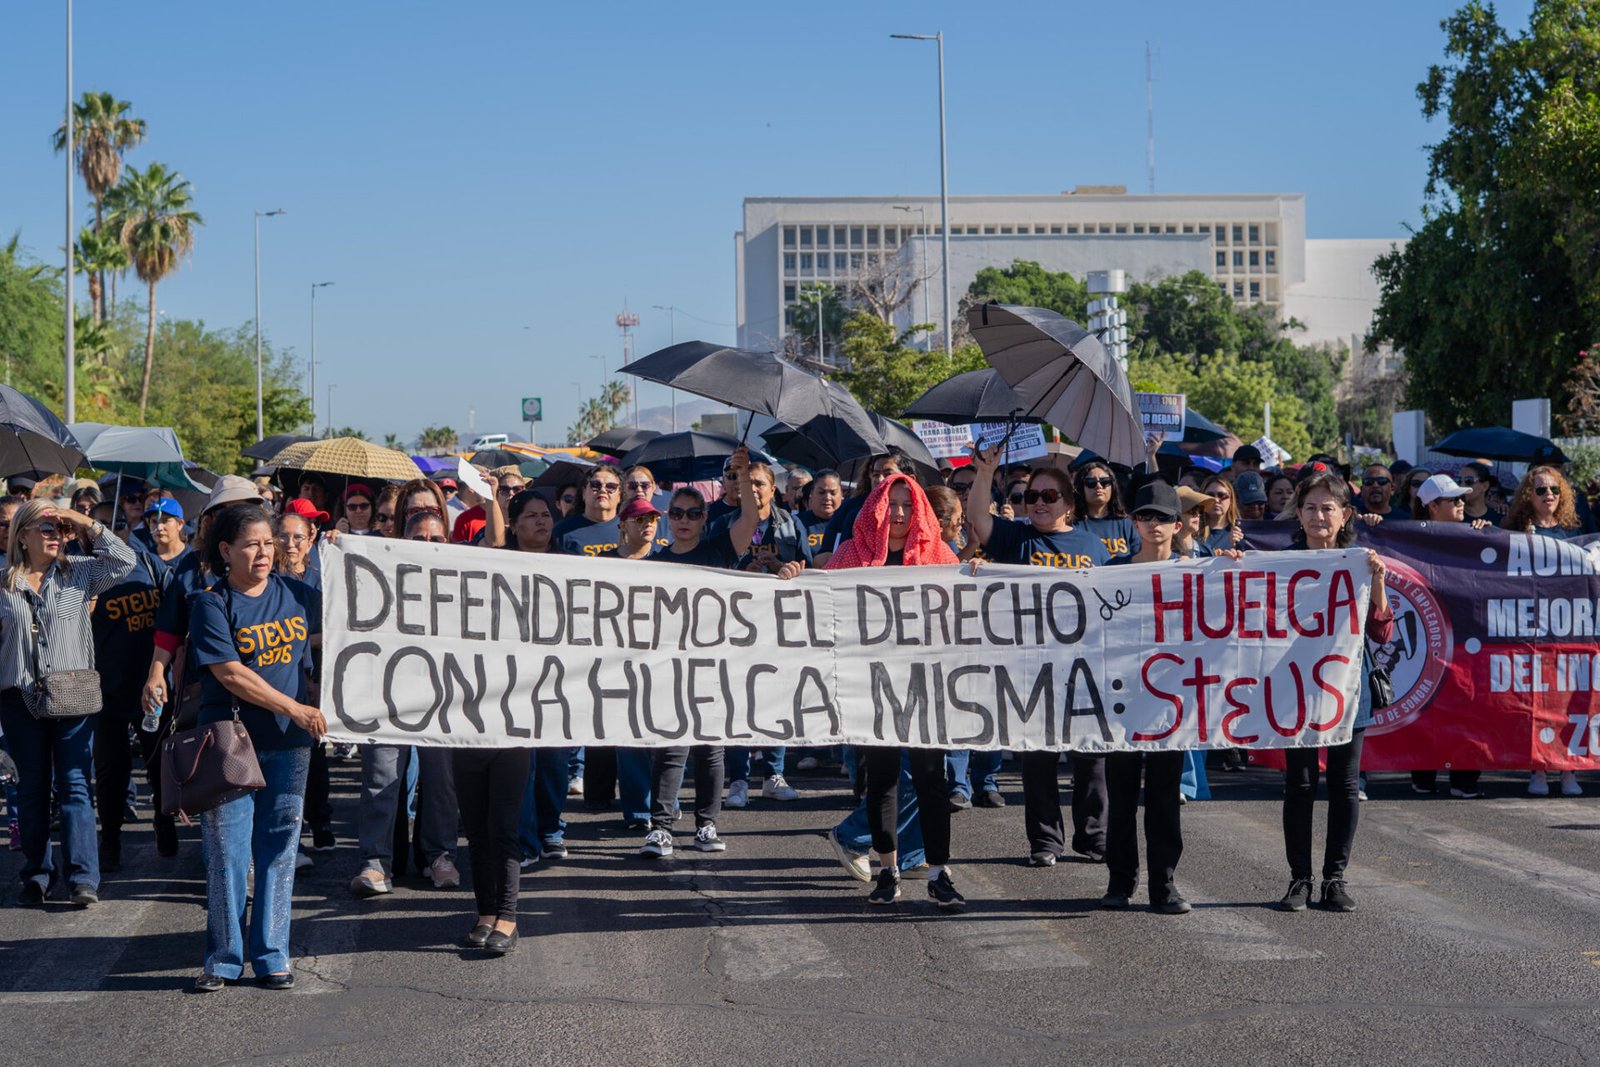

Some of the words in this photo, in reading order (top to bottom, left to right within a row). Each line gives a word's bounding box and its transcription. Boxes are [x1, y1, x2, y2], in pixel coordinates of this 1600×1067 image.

[1151, 414, 1180, 425] DEBAJO
[1507, 533, 1600, 577] AUM
[105, 588, 160, 620] STEUS
[344, 552, 757, 650] DEFENDEREMOS
[774, 590, 835, 647] EL
[856, 581, 1086, 646] DERECHO
[1092, 587, 1132, 621] de
[1152, 569, 1360, 643] HUELGA
[1410, 587, 1441, 648] EMPLEADOS
[1487, 598, 1600, 637] MEJOR
[126, 611, 154, 632] 1976
[237, 616, 307, 653] STEUS
[257, 644, 292, 667] 1976
[1490, 654, 1549, 693] DEL
[332, 641, 487, 734] CON
[500, 654, 572, 739] LA
[588, 657, 840, 741] HUELGA
[870, 657, 1126, 746] MISMA:
[1401, 678, 1434, 713] SONORA
